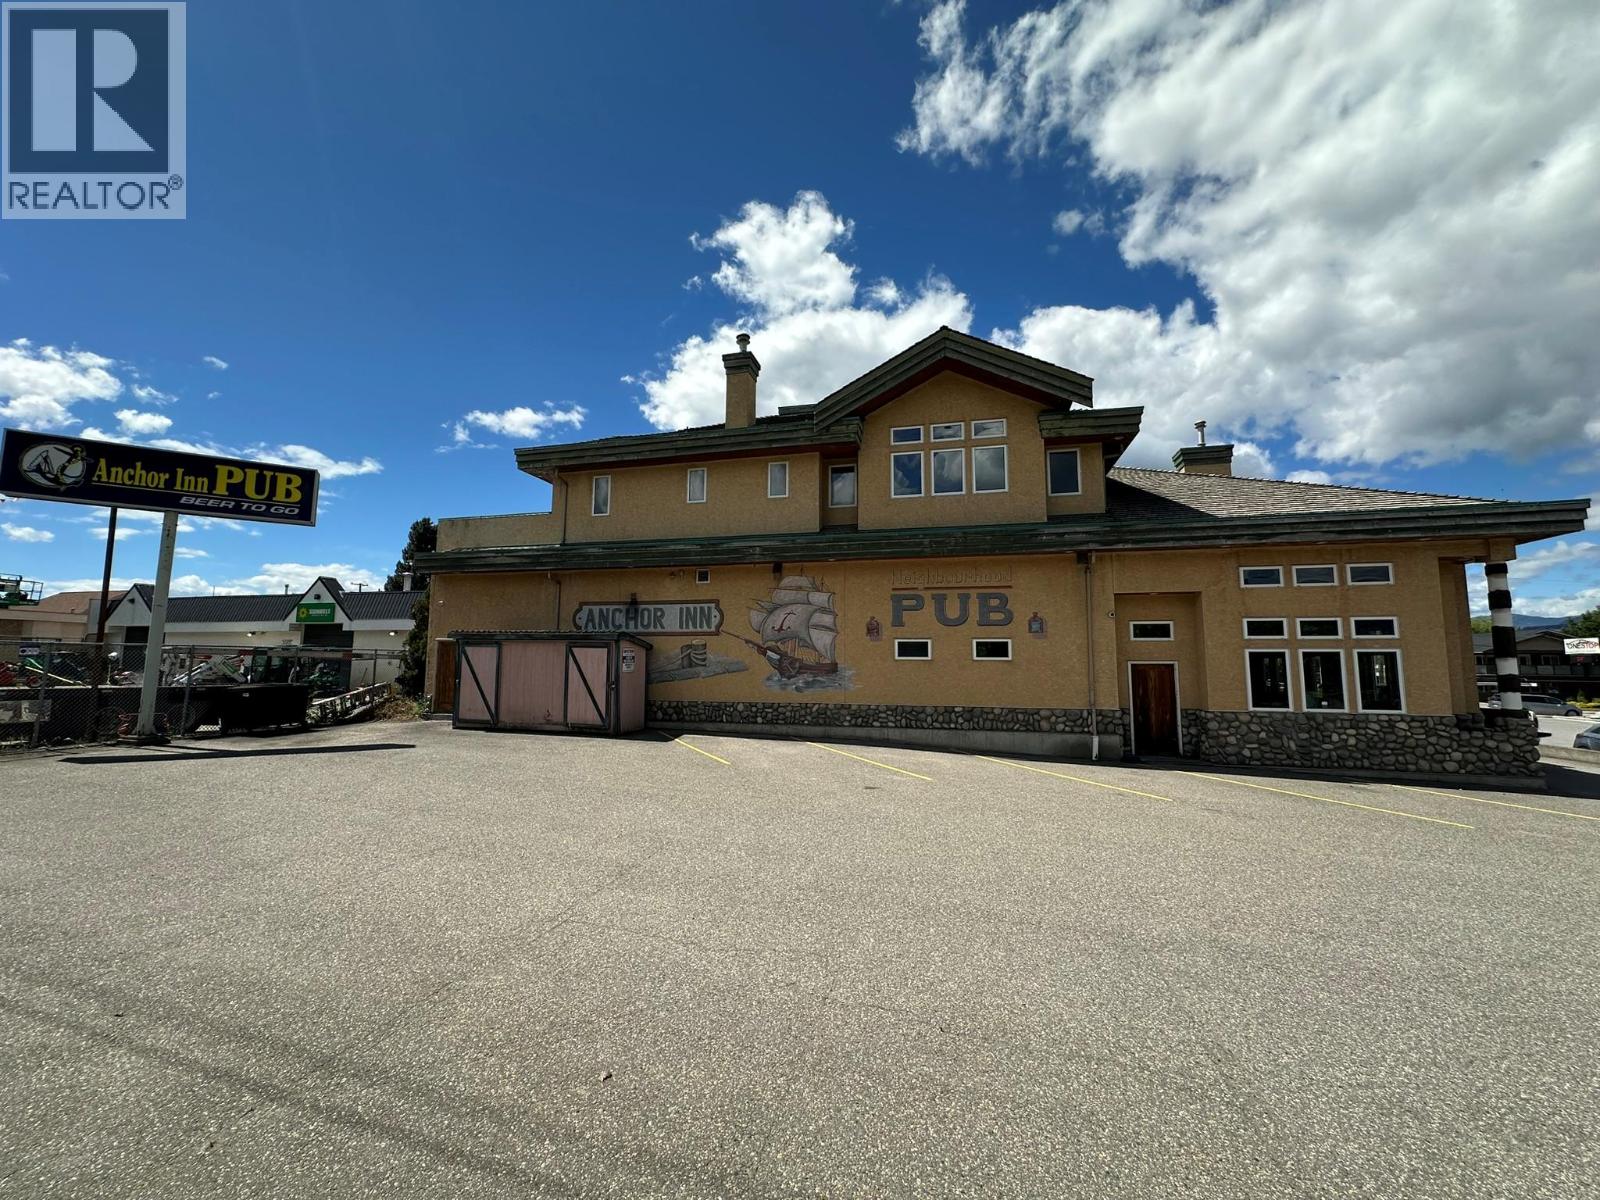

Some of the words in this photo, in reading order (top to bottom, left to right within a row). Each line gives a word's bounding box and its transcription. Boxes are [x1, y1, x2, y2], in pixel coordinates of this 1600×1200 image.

[92, 458, 169, 488] Anchor
[175, 467, 209, 494] Inn
[212, 464, 303, 503] PUB
[179, 496, 235, 509] BEER
[240, 502, 265, 513] TO
[270, 506, 300, 516] GO
[584, 606, 666, 631] ANCHOR
[678, 605, 713, 630] INN
[890, 592, 1014, 628] PUB
